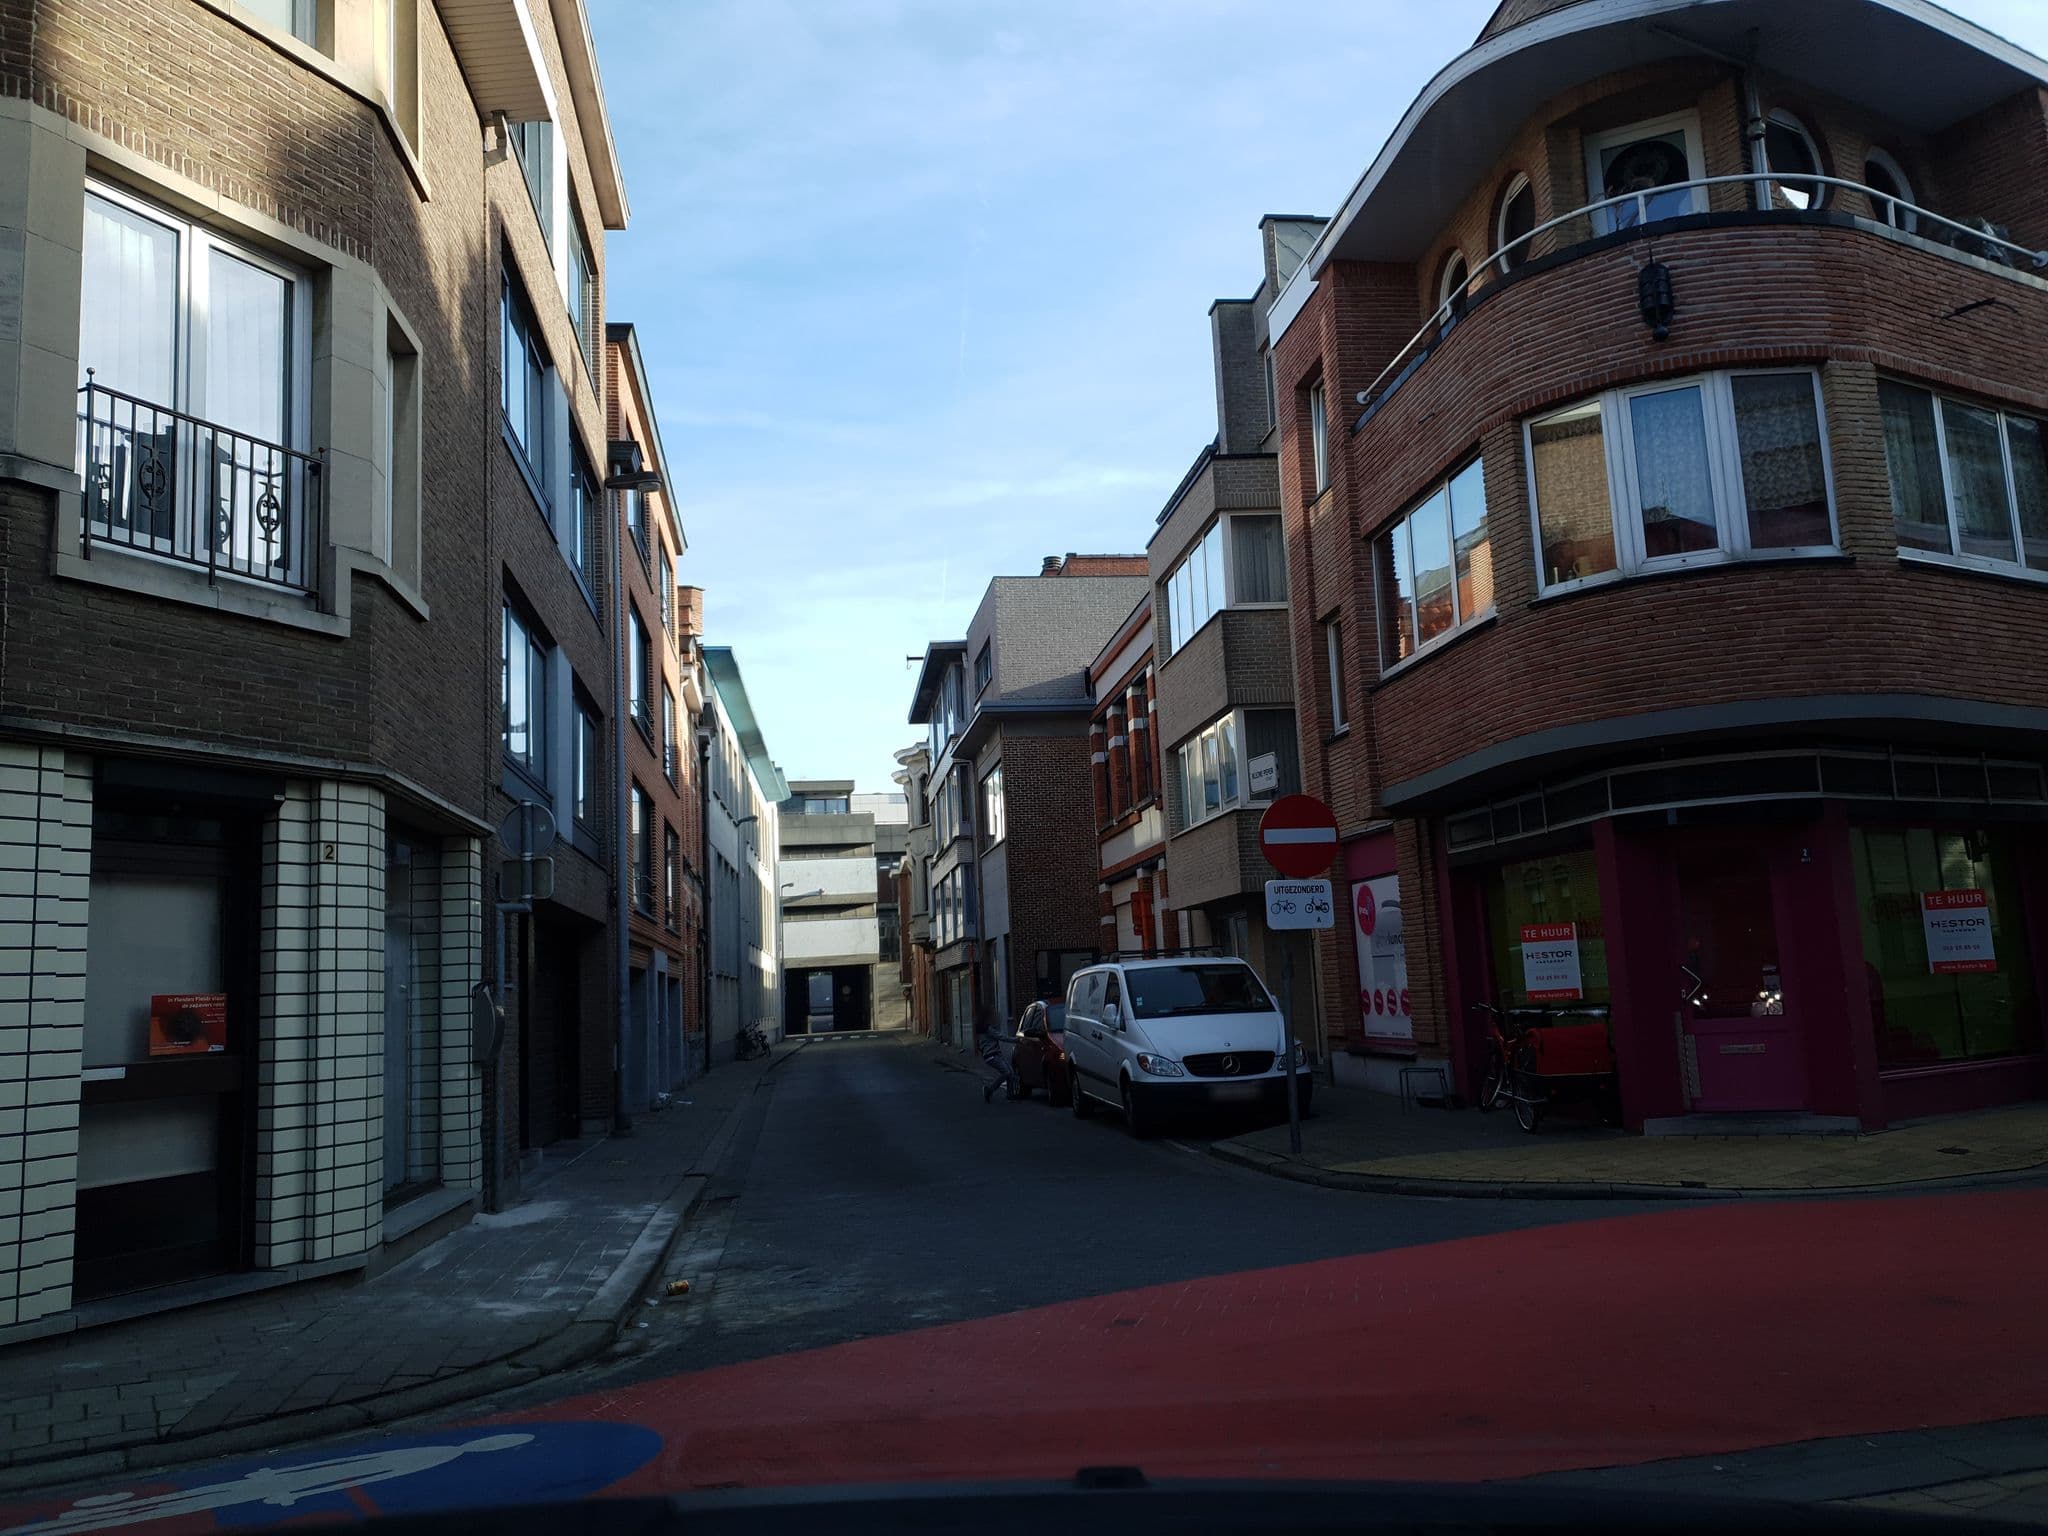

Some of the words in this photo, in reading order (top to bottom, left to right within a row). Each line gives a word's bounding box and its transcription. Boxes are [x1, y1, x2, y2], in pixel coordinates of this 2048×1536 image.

[325, 844, 335, 860] 2
[1273, 884, 1325, 895] UITGEZONDERD
[1928, 896, 1942, 905] TE
[1947, 893, 1984, 904] HUUR
[1930, 918, 1985, 928] HESTOR
[1524, 929, 1537, 938] TE
[1541, 927, 1571, 937] HUUR
[1526, 950, 1573, 960] HESTOR
